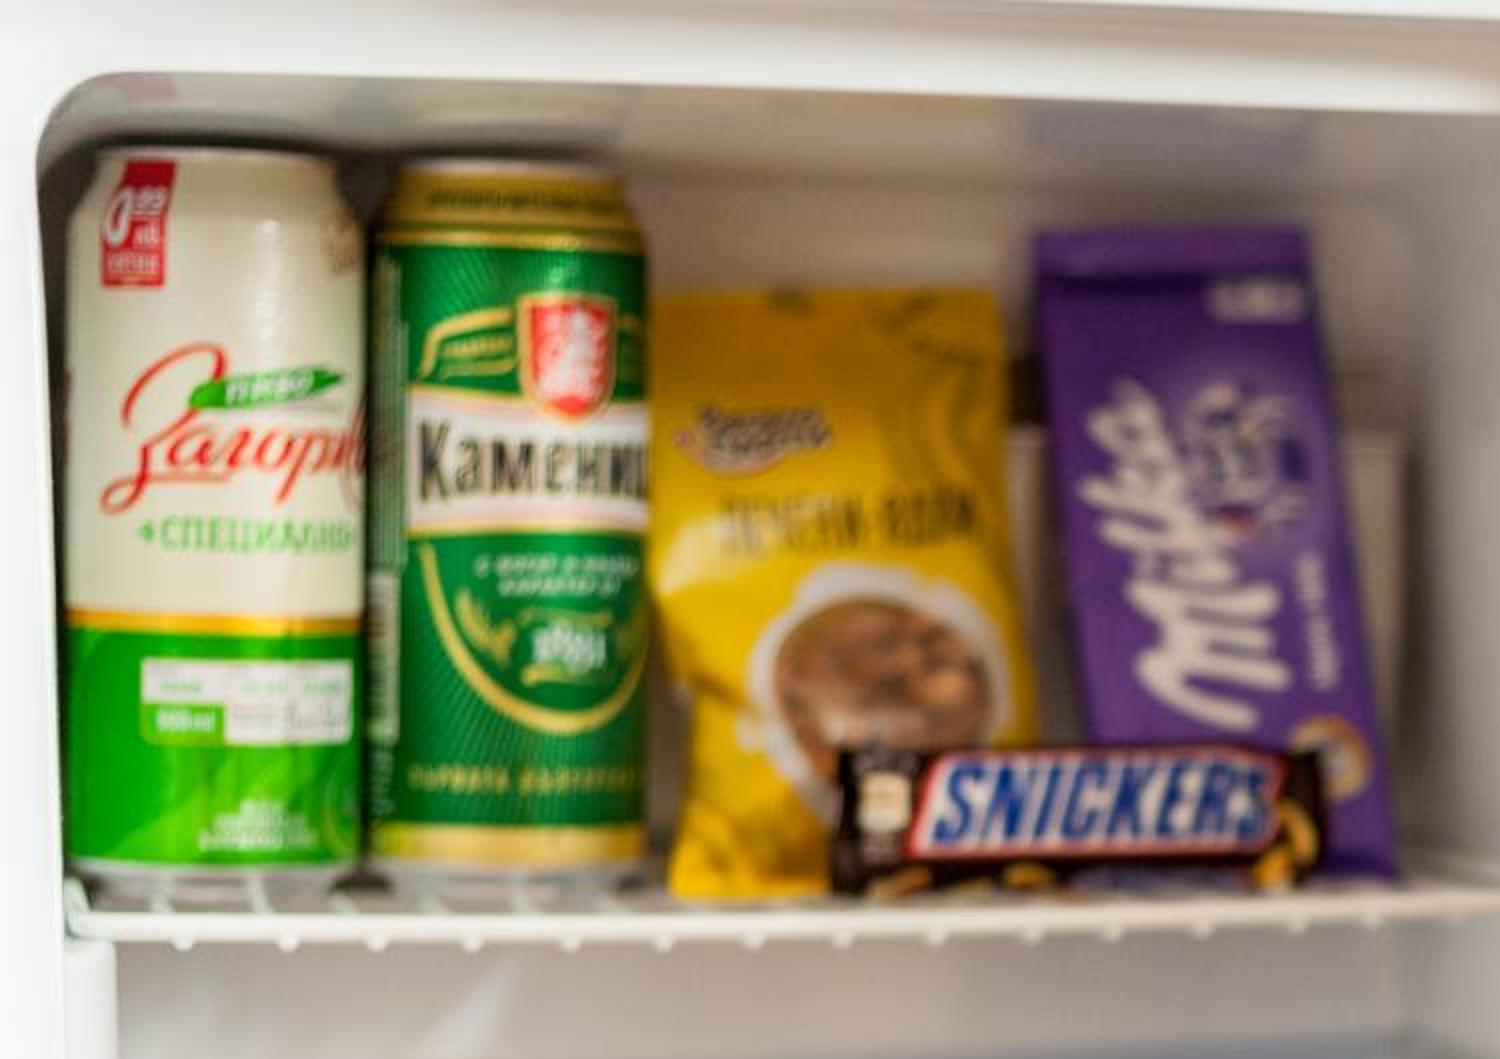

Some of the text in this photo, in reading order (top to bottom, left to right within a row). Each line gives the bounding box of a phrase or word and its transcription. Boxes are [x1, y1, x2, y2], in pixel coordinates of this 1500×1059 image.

[101, 342, 366, 518] Загорк
[1082, 375, 1290, 730] Milka
[933, 757, 1272, 845] SNICKERS
